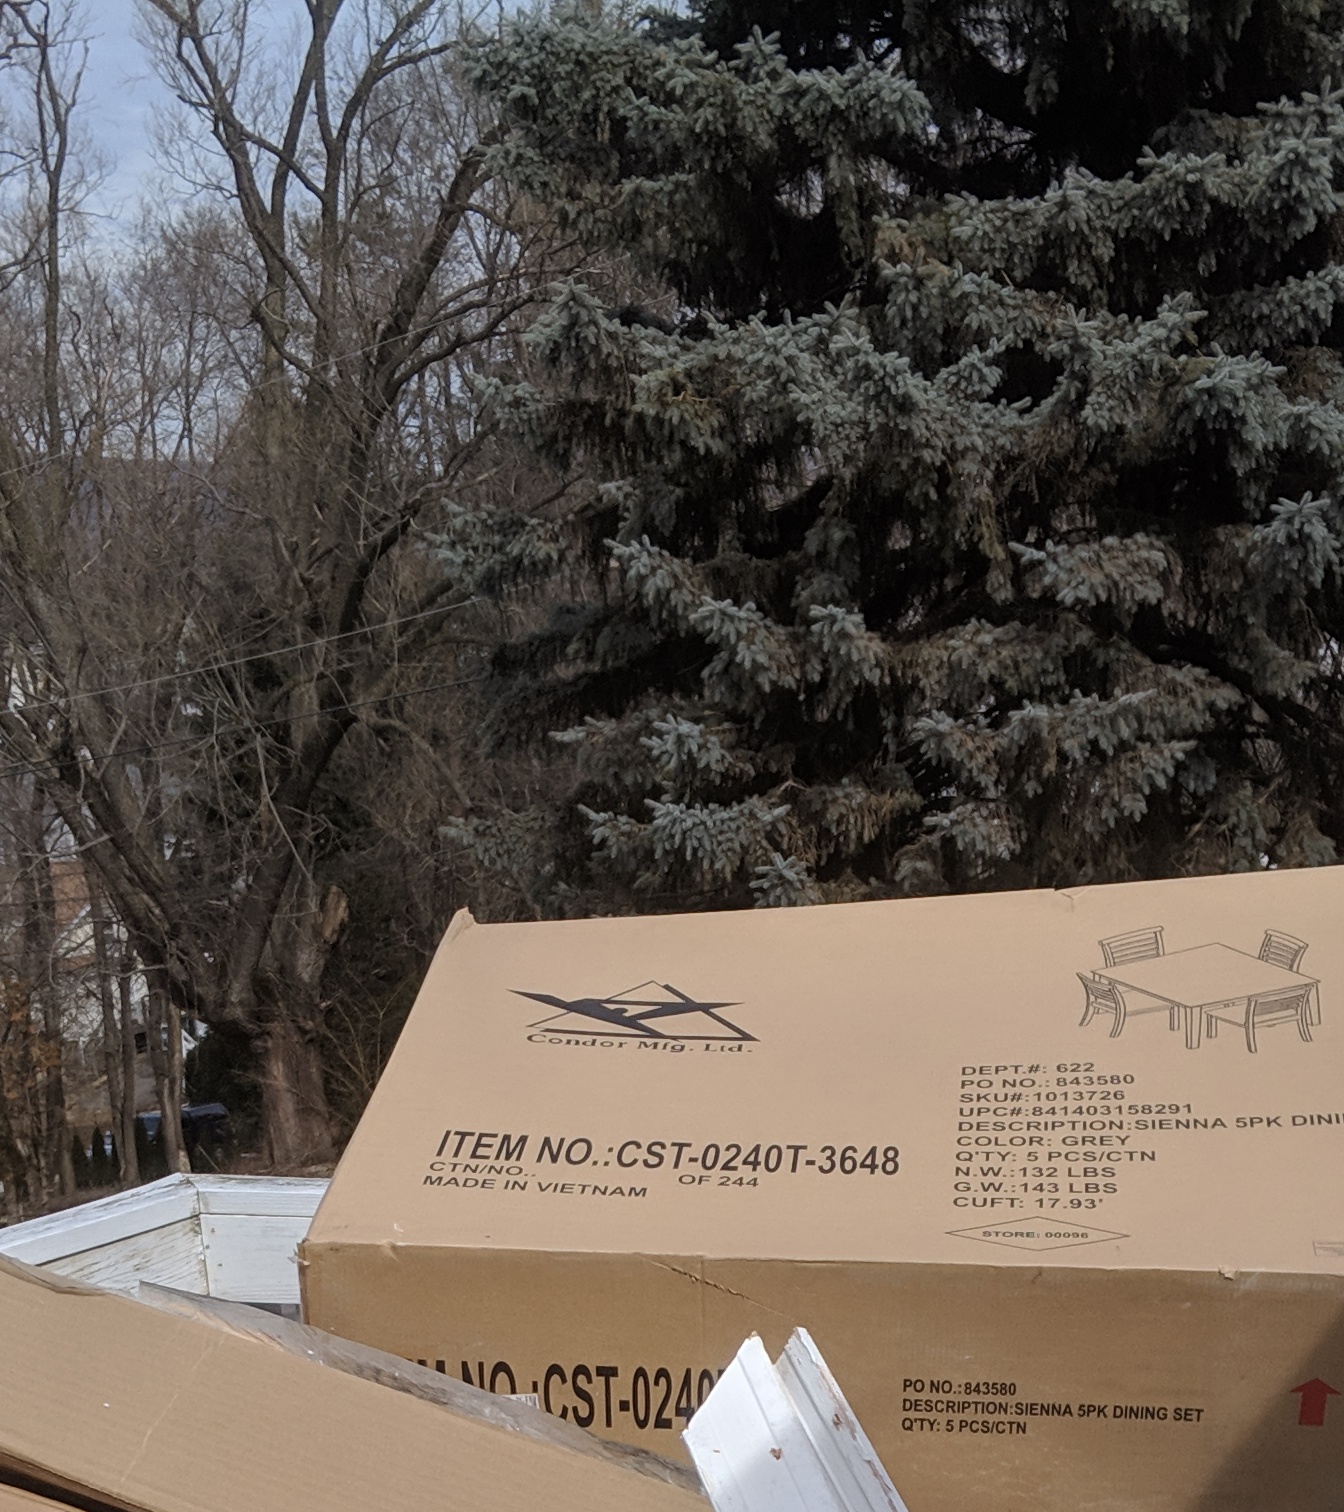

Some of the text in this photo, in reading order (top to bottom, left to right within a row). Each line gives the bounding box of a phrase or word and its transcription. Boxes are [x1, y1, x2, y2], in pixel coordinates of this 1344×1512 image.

[526, 1033, 753, 1053] Condor Mfg. Ltd.
[960, 1062, 1095, 1076] DEPT.#: 622
[960, 1074, 1135, 1090] PO NO.: 843580
[959, 1090, 1126, 1103] SKU#:1013726
[958, 1103, 1193, 1118] UPC#:841403158291
[957, 1117, 1228, 1132] DESCRIPTION:SIENNA
[1235, 1114, 1283, 1129] 5PK
[956, 1135, 1131, 1147] COLOR: GREY
[435, 1129, 901, 1176] ITEM NO.:CST-0240T-3648
[955, 1150, 1156, 1163] Q'TY: 5 PCS/CTN
[954, 1166, 1117, 1178] N.W.:132 LBS
[422, 1175, 647, 1198] MADE IN VIETNAM
[678, 1174, 711, 1187] OF
[717, 1175, 760, 1188] 244
[953, 1181, 1118, 1194] G.W.:143 LBS
[952, 1196, 1024, 1209] CUFT:
[982, 1230, 1041, 1239] STORE:
[902, 1378, 1017, 1396] PO NO.:843580
[902, 1398, 1204, 1423] DESCRIPTION:SIENNA 5PK DINING SET
[901, 1417, 1027, 1435] Q'TY: 5 PCS/CTN
